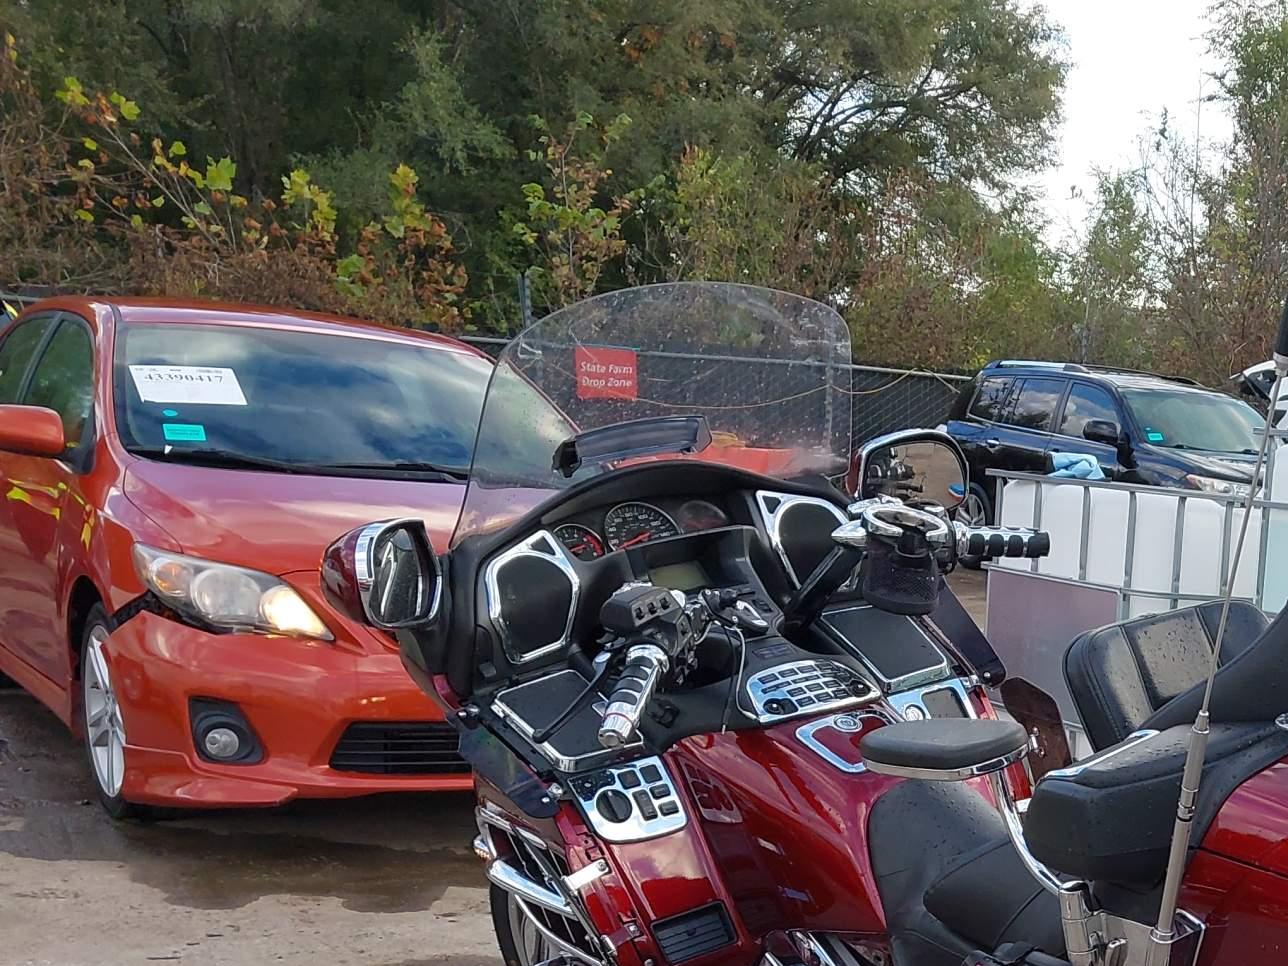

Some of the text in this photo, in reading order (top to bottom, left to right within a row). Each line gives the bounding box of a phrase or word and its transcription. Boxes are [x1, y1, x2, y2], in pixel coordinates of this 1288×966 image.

[580, 361, 633, 375] State Farm
[582, 377, 633, 389] Drop Zone
